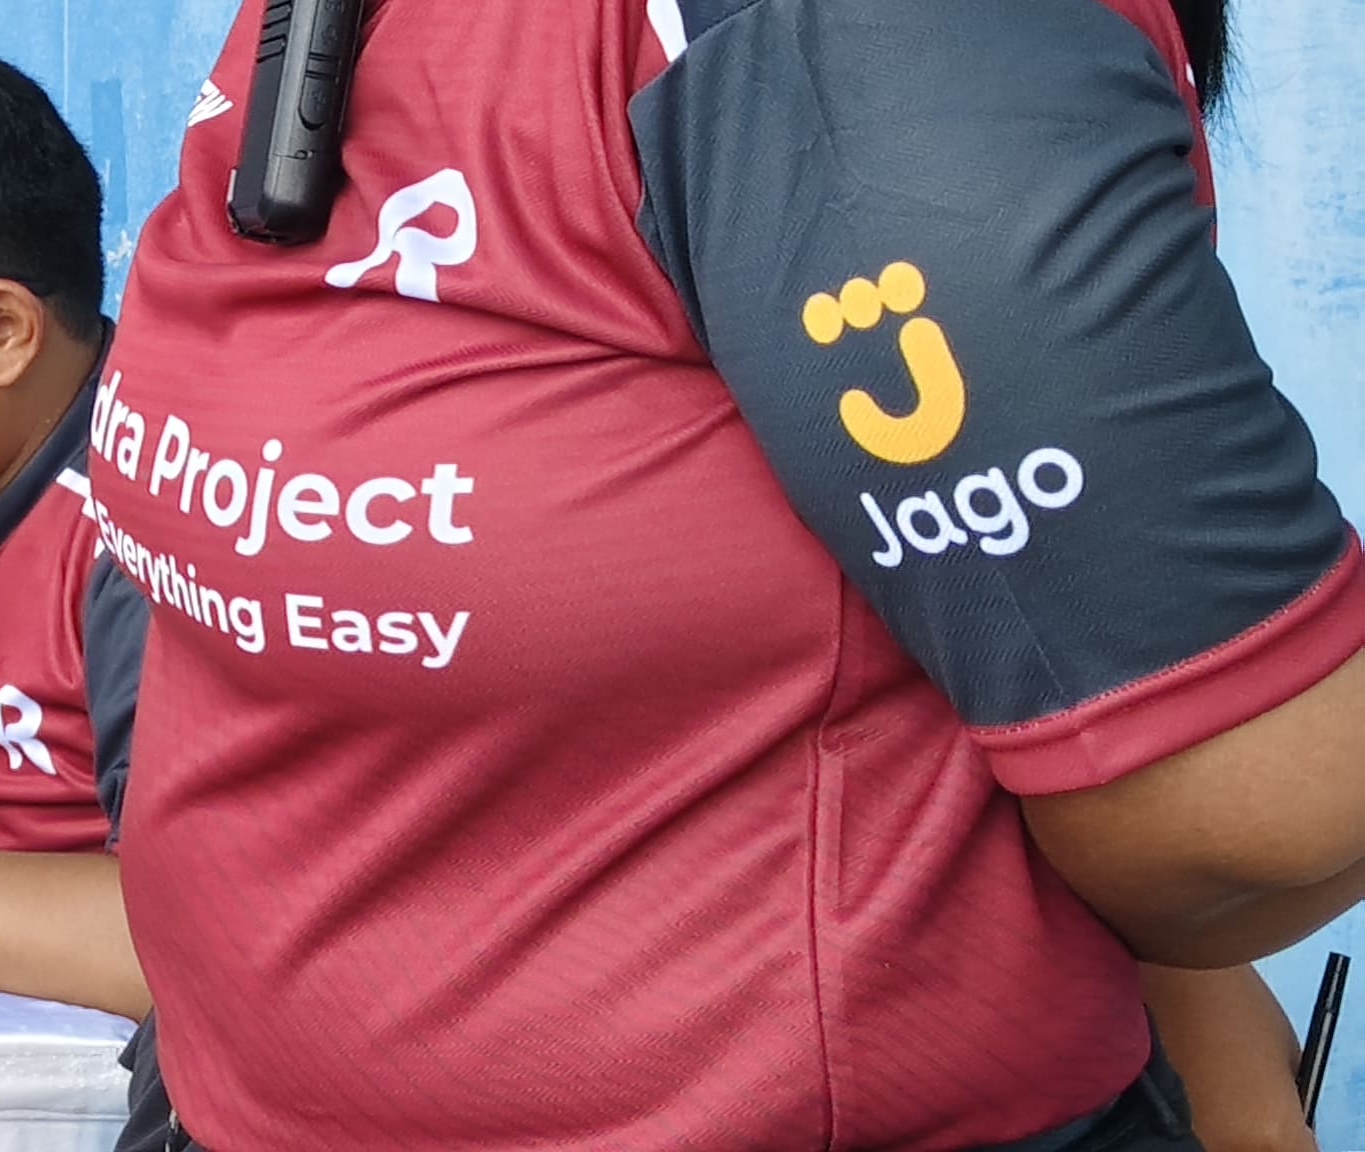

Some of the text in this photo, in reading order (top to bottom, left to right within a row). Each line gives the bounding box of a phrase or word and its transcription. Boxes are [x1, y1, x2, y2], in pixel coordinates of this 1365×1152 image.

[325, 168, 478, 303] R
[149, 414, 475, 557] Project
[859, 446, 1084, 568] Jago
[94, 499, 471, 669] Everything Easy
